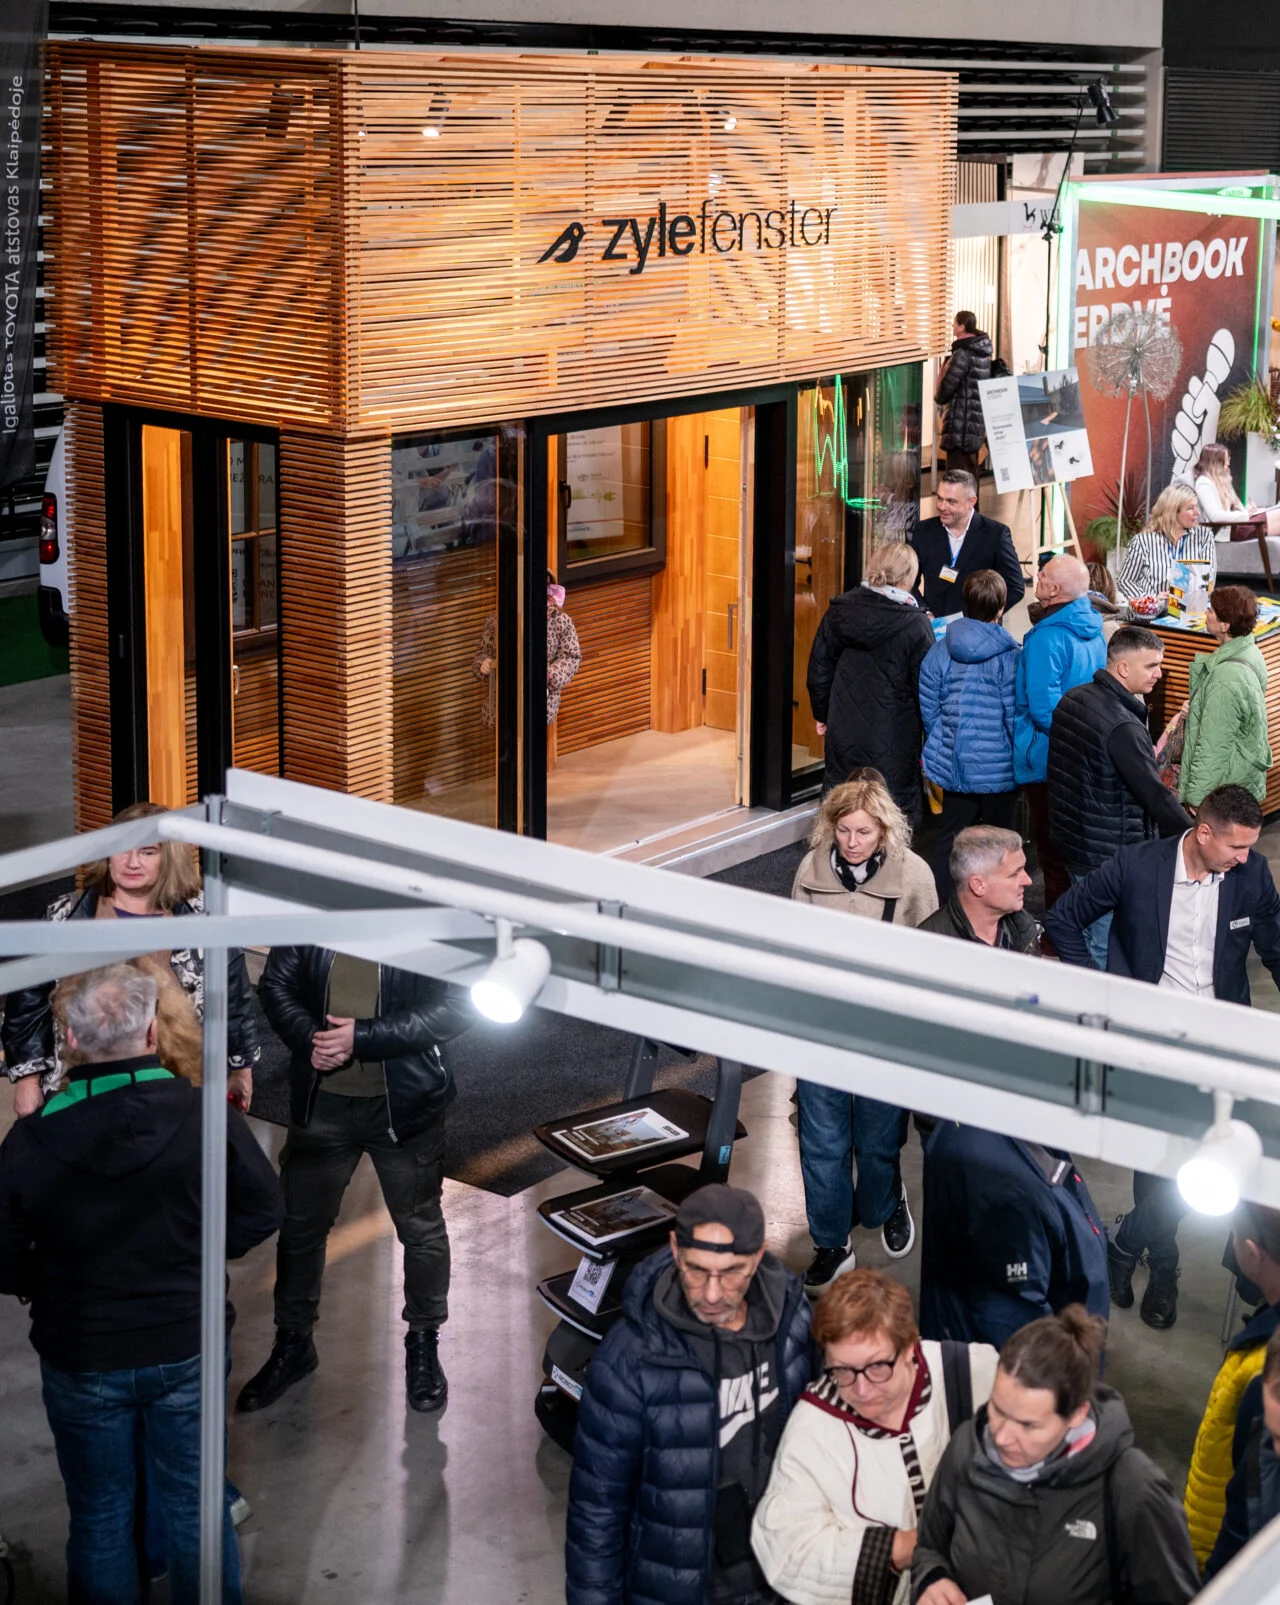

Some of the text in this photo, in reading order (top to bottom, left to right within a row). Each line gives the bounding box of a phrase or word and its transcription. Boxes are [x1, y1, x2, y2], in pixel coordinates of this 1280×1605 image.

[6, 75, 25, 179] Klaipėdoje
[5, 185, 20, 265] atstovas
[601, 199, 838, 275] zylefenster
[1075, 236, 1249, 291] ARCHBOOK
[5, 270, 20, 349] TOYOTA
[1006, 1261, 1028, 1277] HH
